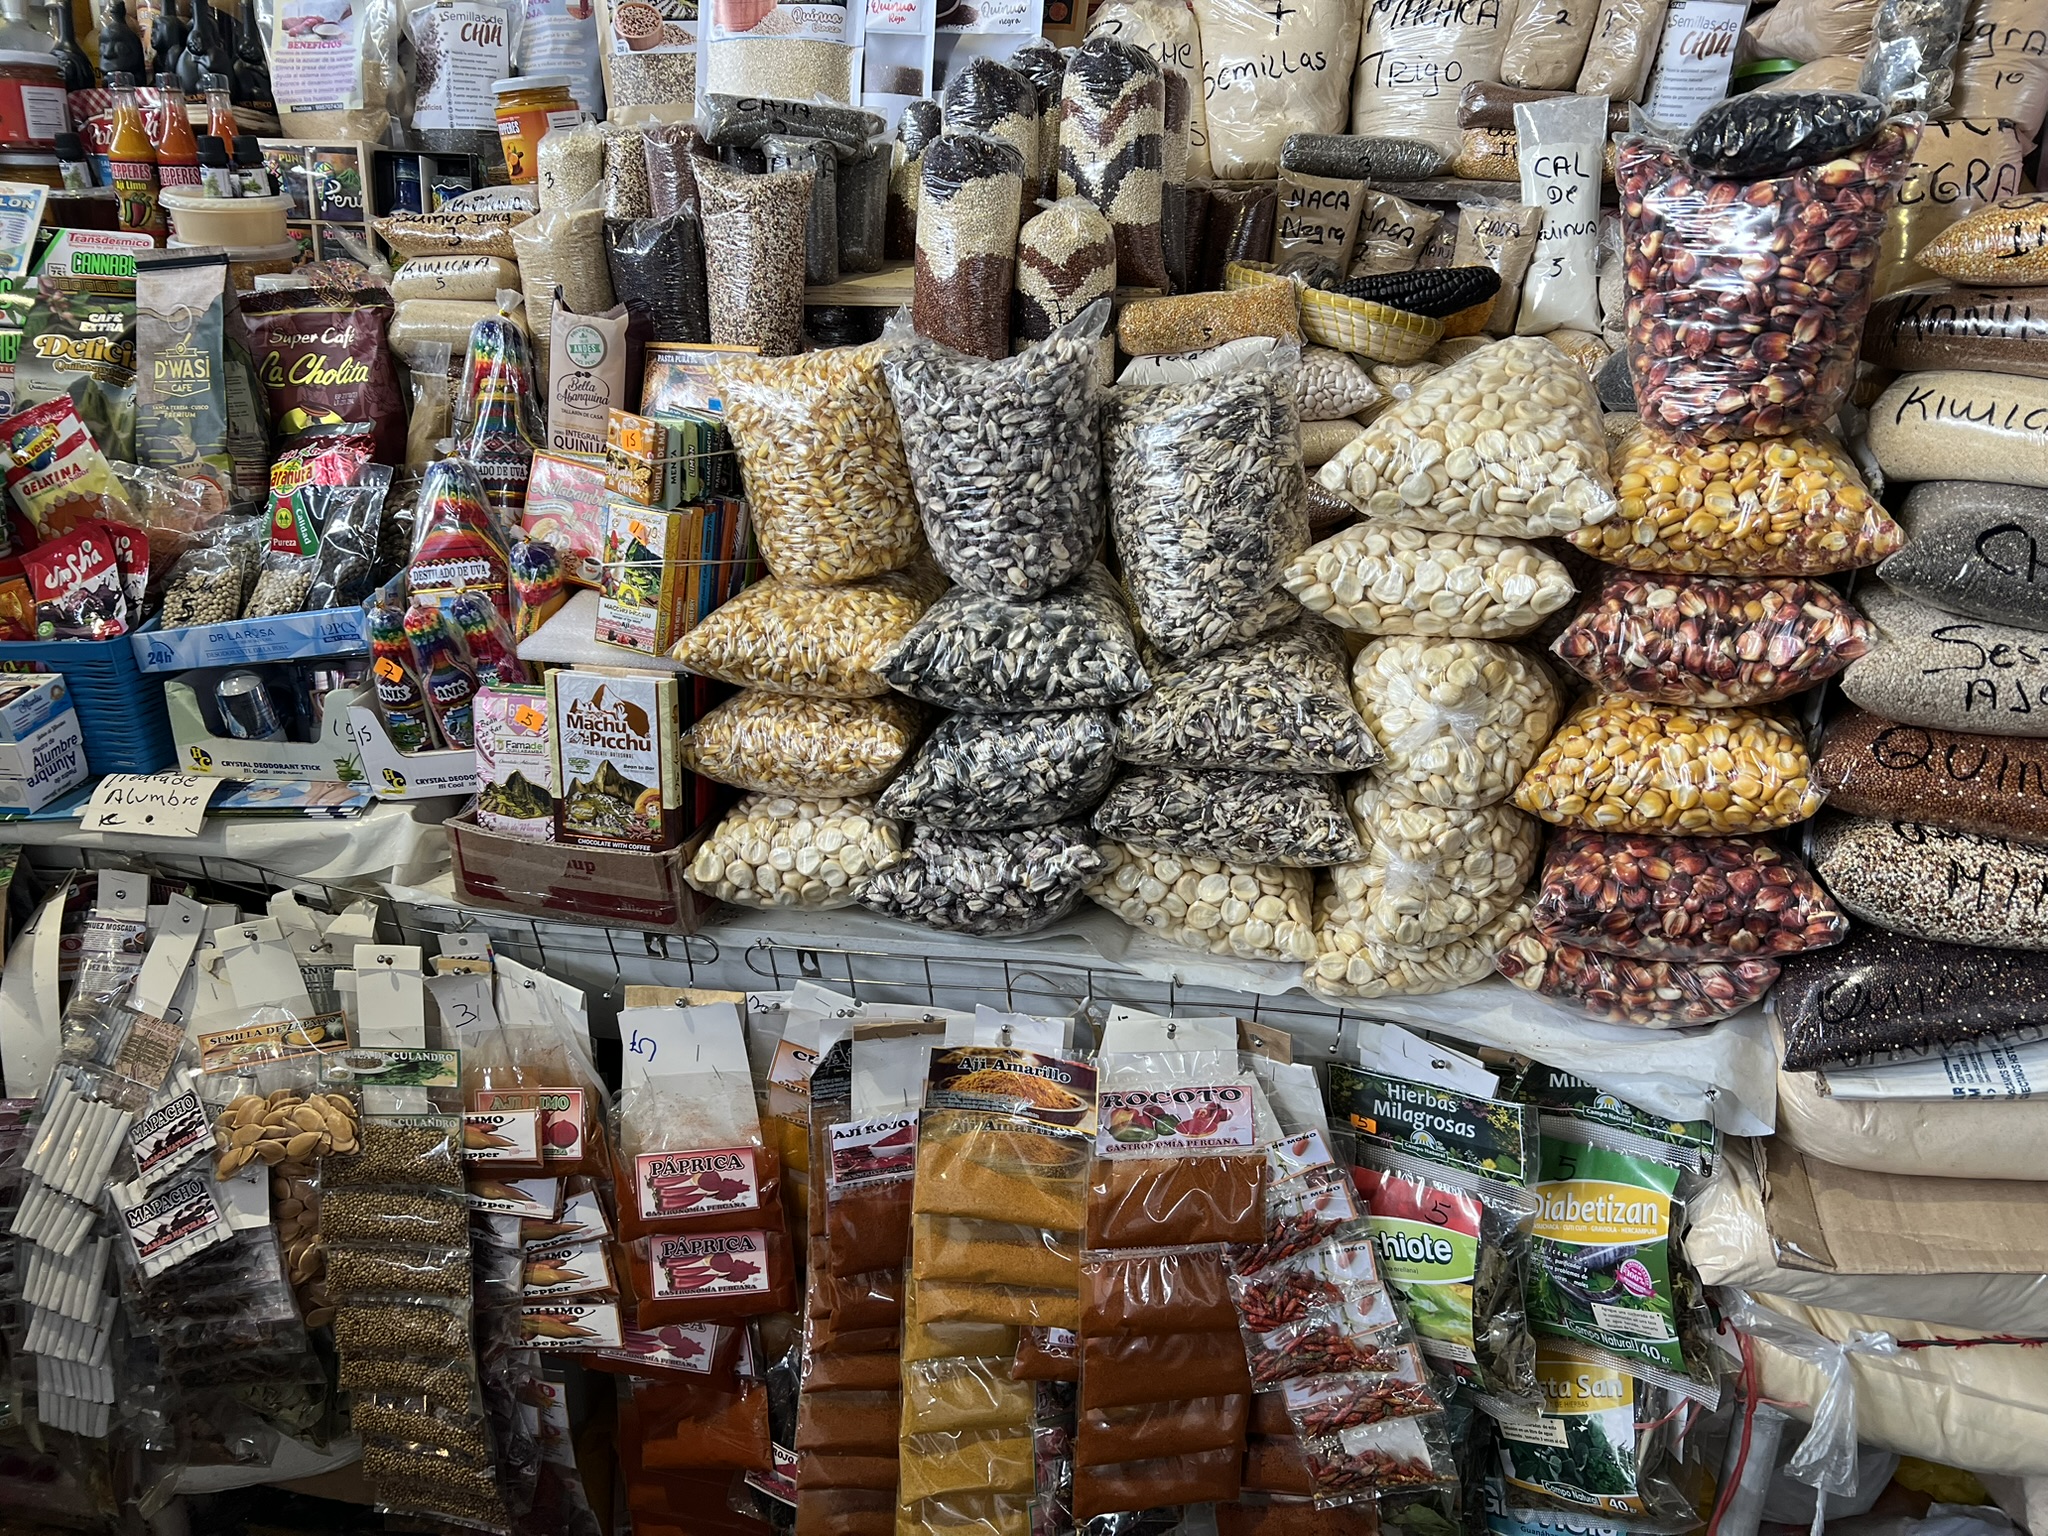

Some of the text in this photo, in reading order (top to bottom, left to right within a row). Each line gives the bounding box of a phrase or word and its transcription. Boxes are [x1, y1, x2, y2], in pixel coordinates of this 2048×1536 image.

[443, 11, 503, 24] Semillas de
[888, 13, 906, 24] Roja
[999, 17, 1021, 27] negra
[1672, 14, 1737, 31] Semillas de
[288, 40, 342, 49] BENEFICIOS
[1996, 70, 2024, 90] 10
[1358, 156, 1372, 173] 3
[1535, 152, 1589, 179] CAL
[126, 181, 147, 190] Limo
[544, 171, 554, 189] 3
[68, 232, 150, 247] Transdermico
[435, 277, 446, 291] 5
[88, 312, 124, 323] CAFÉ
[79, 321, 124, 333] EXTRA
[269, 325, 356, 349] Super Café
[573, 343, 597, 353] ANDES
[657, 355, 675, 363] PASTA
[288, 353, 369, 387] Cholita
[568, 378, 596, 393] Bella
[565, 430, 600, 442] INTEGRAL
[626, 432, 635, 448] 15
[657, 446, 664, 457] DE
[22, 462, 81, 496] GELATINA
[494, 465, 526, 477] DE UVA
[295, 508, 312, 545] Calidad
[273, 538, 297, 547] Pureza
[458, 566, 468, 577] DE
[469, 564, 488, 576] UVA
[174, 597, 194, 622] 5
[147, 650, 172, 665] 24h
[383, 661, 394, 678] 7
[379, 689, 406, 700] ANIS
[437, 682, 467, 699] ANIS
[521, 713, 534, 727] 5
[566, 713, 627, 734] Machu
[505, 740, 543, 750] Famade
[590, 732, 651, 751] Picchu
[34, 734, 78, 771] Alumbre
[27, 750, 76, 788] Alumbre
[222, 760, 251, 768] CRYSTAL
[253, 762, 299, 771] DEODORANT
[415, 776, 448, 785] CRYSTAL
[104, 788, 199, 806] Alumbre
[578, 838, 651, 851] CHOCOLATE WITH COFFEE
[87, 922, 137, 932] NUEZ MOSCADA
[452, 1004, 477, 1028] 3
[209, 1029, 264, 1045] SEMILLA
[266, 1026, 283, 1038] DE
[391, 1052, 454, 1063] CULANDRO
[958, 1056, 1072, 1085] Aji Amarillo
[491, 1095, 520, 1111] AJI
[1101, 1087, 1243, 1108] ROCOTO
[1387, 1082, 1457, 1113] Hierbas
[132, 1095, 194, 1141] MAPACHO
[398, 1119, 457, 1128] CULANDRO
[1373, 1099, 1476, 1139] Milagrosas
[1586, 1107, 1632, 1125] Campo Natural
[833, 1119, 910, 1140] AJÍ ROJO
[1105, 1136, 1240, 1153] GASTRONOMÍA PERUANA
[1286, 1132, 1317, 1146] MONO
[1404, 1142, 1446, 1159] Campo Natural
[650, 1154, 745, 1178] PÁPRICA
[1553, 1157, 1577, 1181] 5
[128, 1180, 201, 1227] MAPACHO
[1424, 1200, 1451, 1225] 5
[174, 1216, 208, 1237] NATURAL
[662, 1232, 755, 1257] PÁPRICA
[523, 1285, 571, 1297] pepper
[549, 1306, 585, 1315] LIMO
[532, 1338, 585, 1348] pepper
[1568, 1320, 1600, 1341] Campo
[1601, 1334, 1635, 1350] Natural
[1640, 1343, 1661, 1360] 40
[1577, 1374, 1623, 1398] San
[1564, 1400, 1589, 1408] HIERBAS
[1545, 1481, 1599, 1506] Campo Natural
[1609, 1498, 1628, 1512] 40
